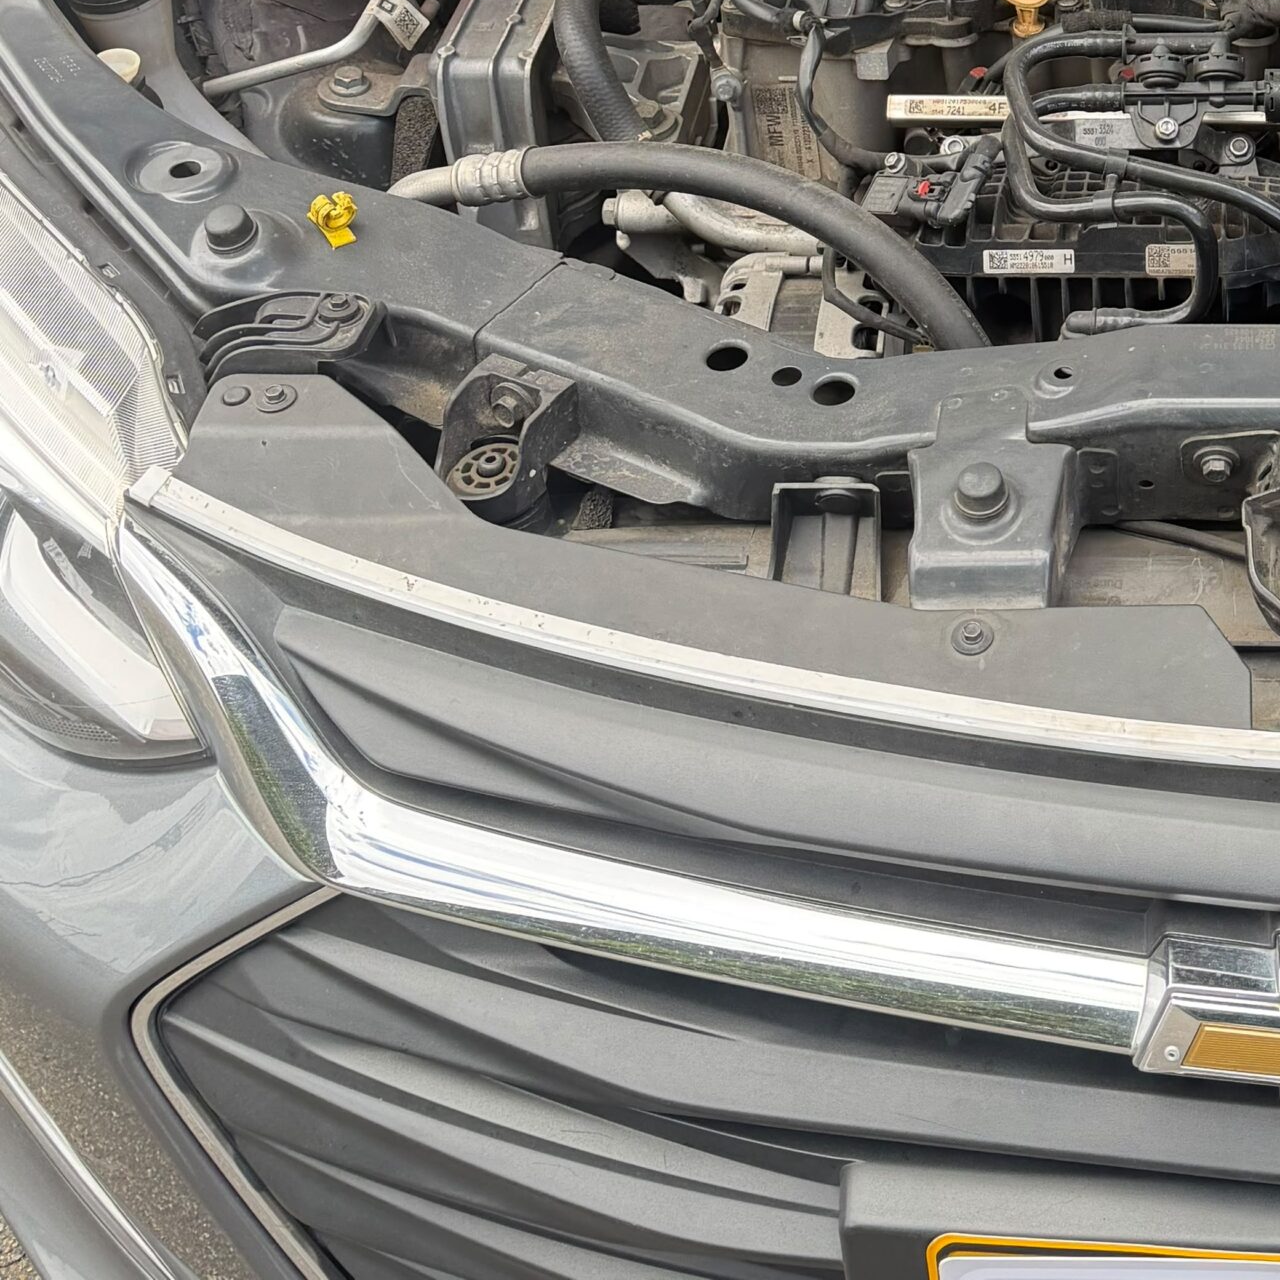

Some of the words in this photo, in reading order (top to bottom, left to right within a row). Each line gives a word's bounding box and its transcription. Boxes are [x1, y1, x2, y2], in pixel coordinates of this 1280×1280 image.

[946, 106, 965, 115] 7241
[765, 114, 784, 147] MFW
[1023, 250, 1044, 262] 4979
[1063, 253, 1073, 265] H
